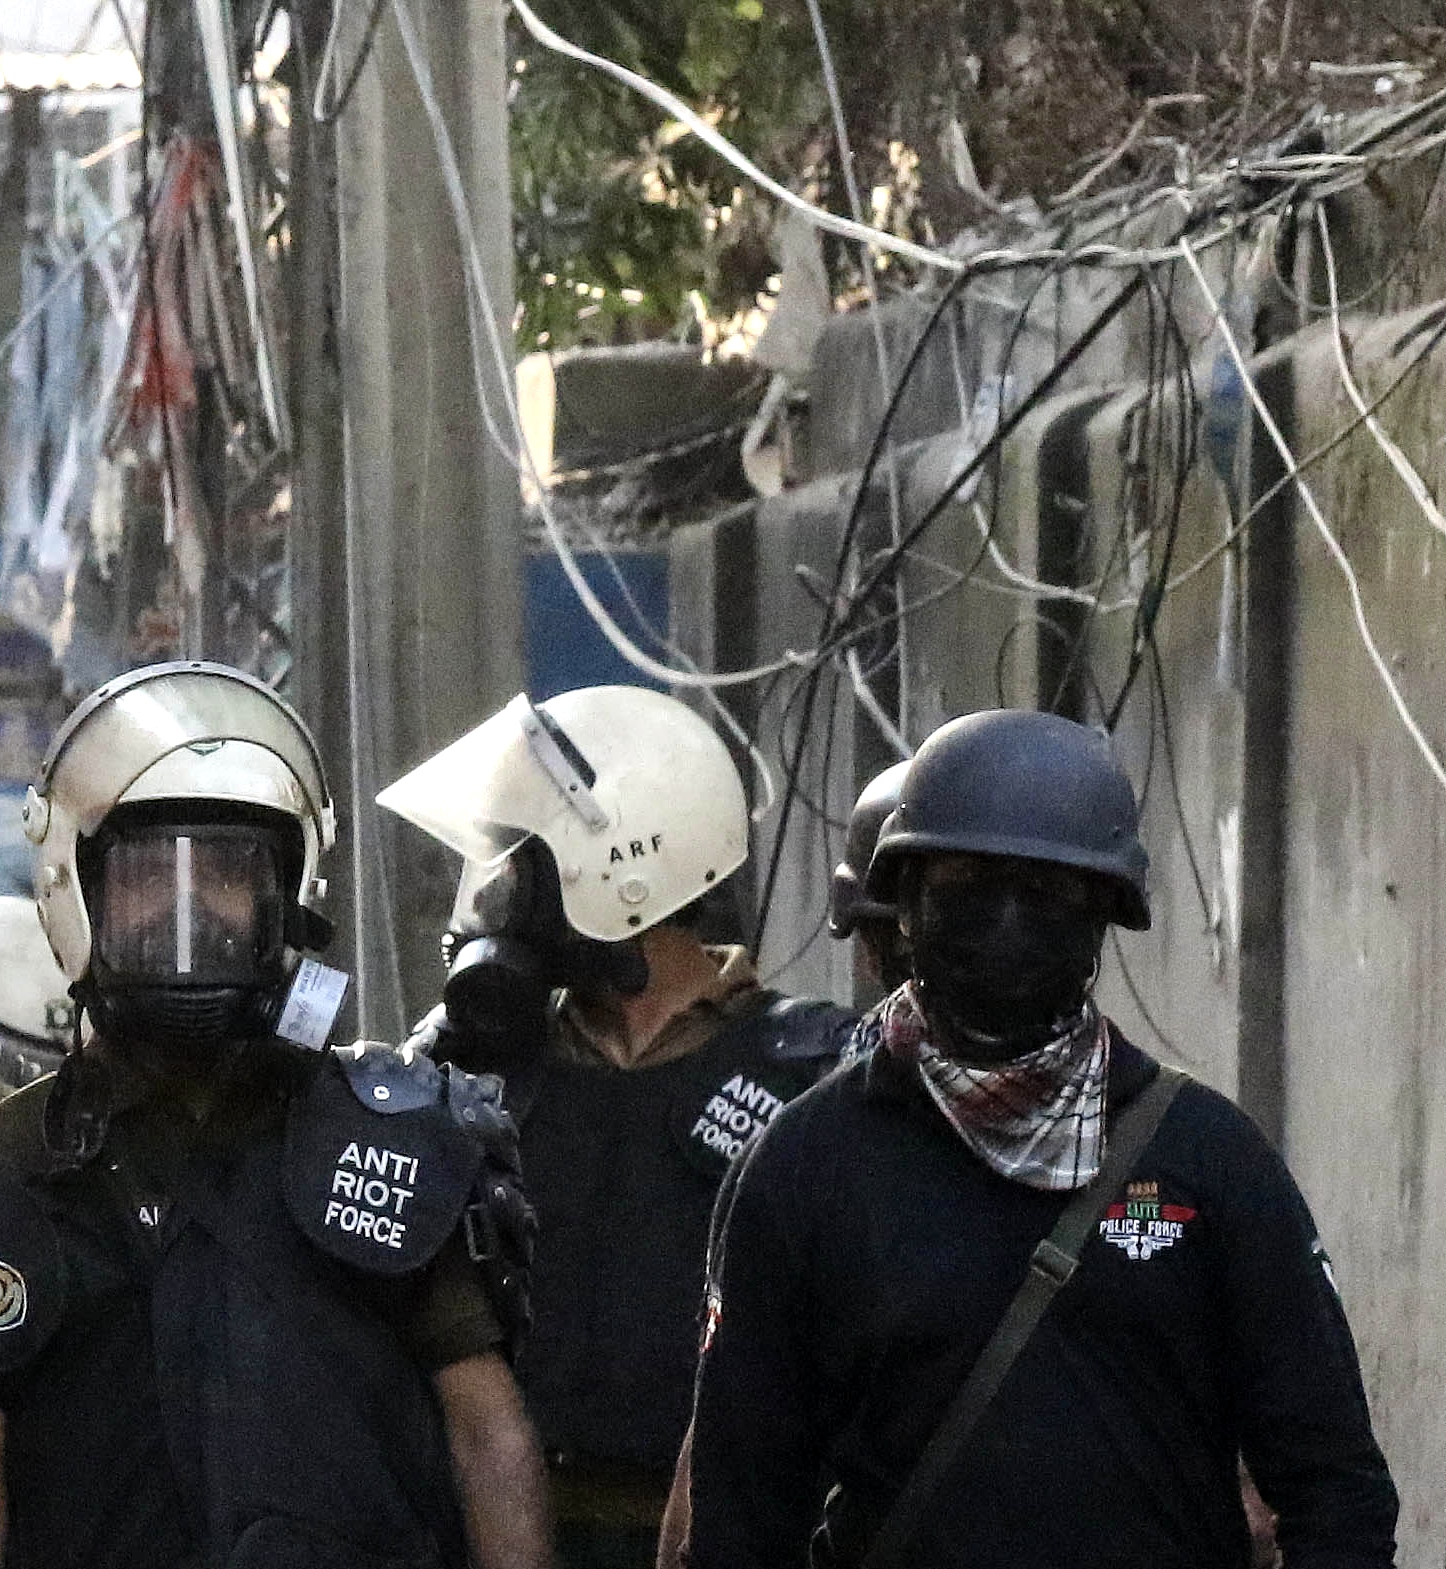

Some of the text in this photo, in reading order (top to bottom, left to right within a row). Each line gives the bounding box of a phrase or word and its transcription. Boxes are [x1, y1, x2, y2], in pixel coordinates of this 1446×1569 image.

[338, 1142, 419, 1185] ANTI
[331, 1169, 414, 1215] RIOT
[324, 1200, 406, 1249] FORCE
[1099, 1219, 1185, 1239] POLICE FORCE
